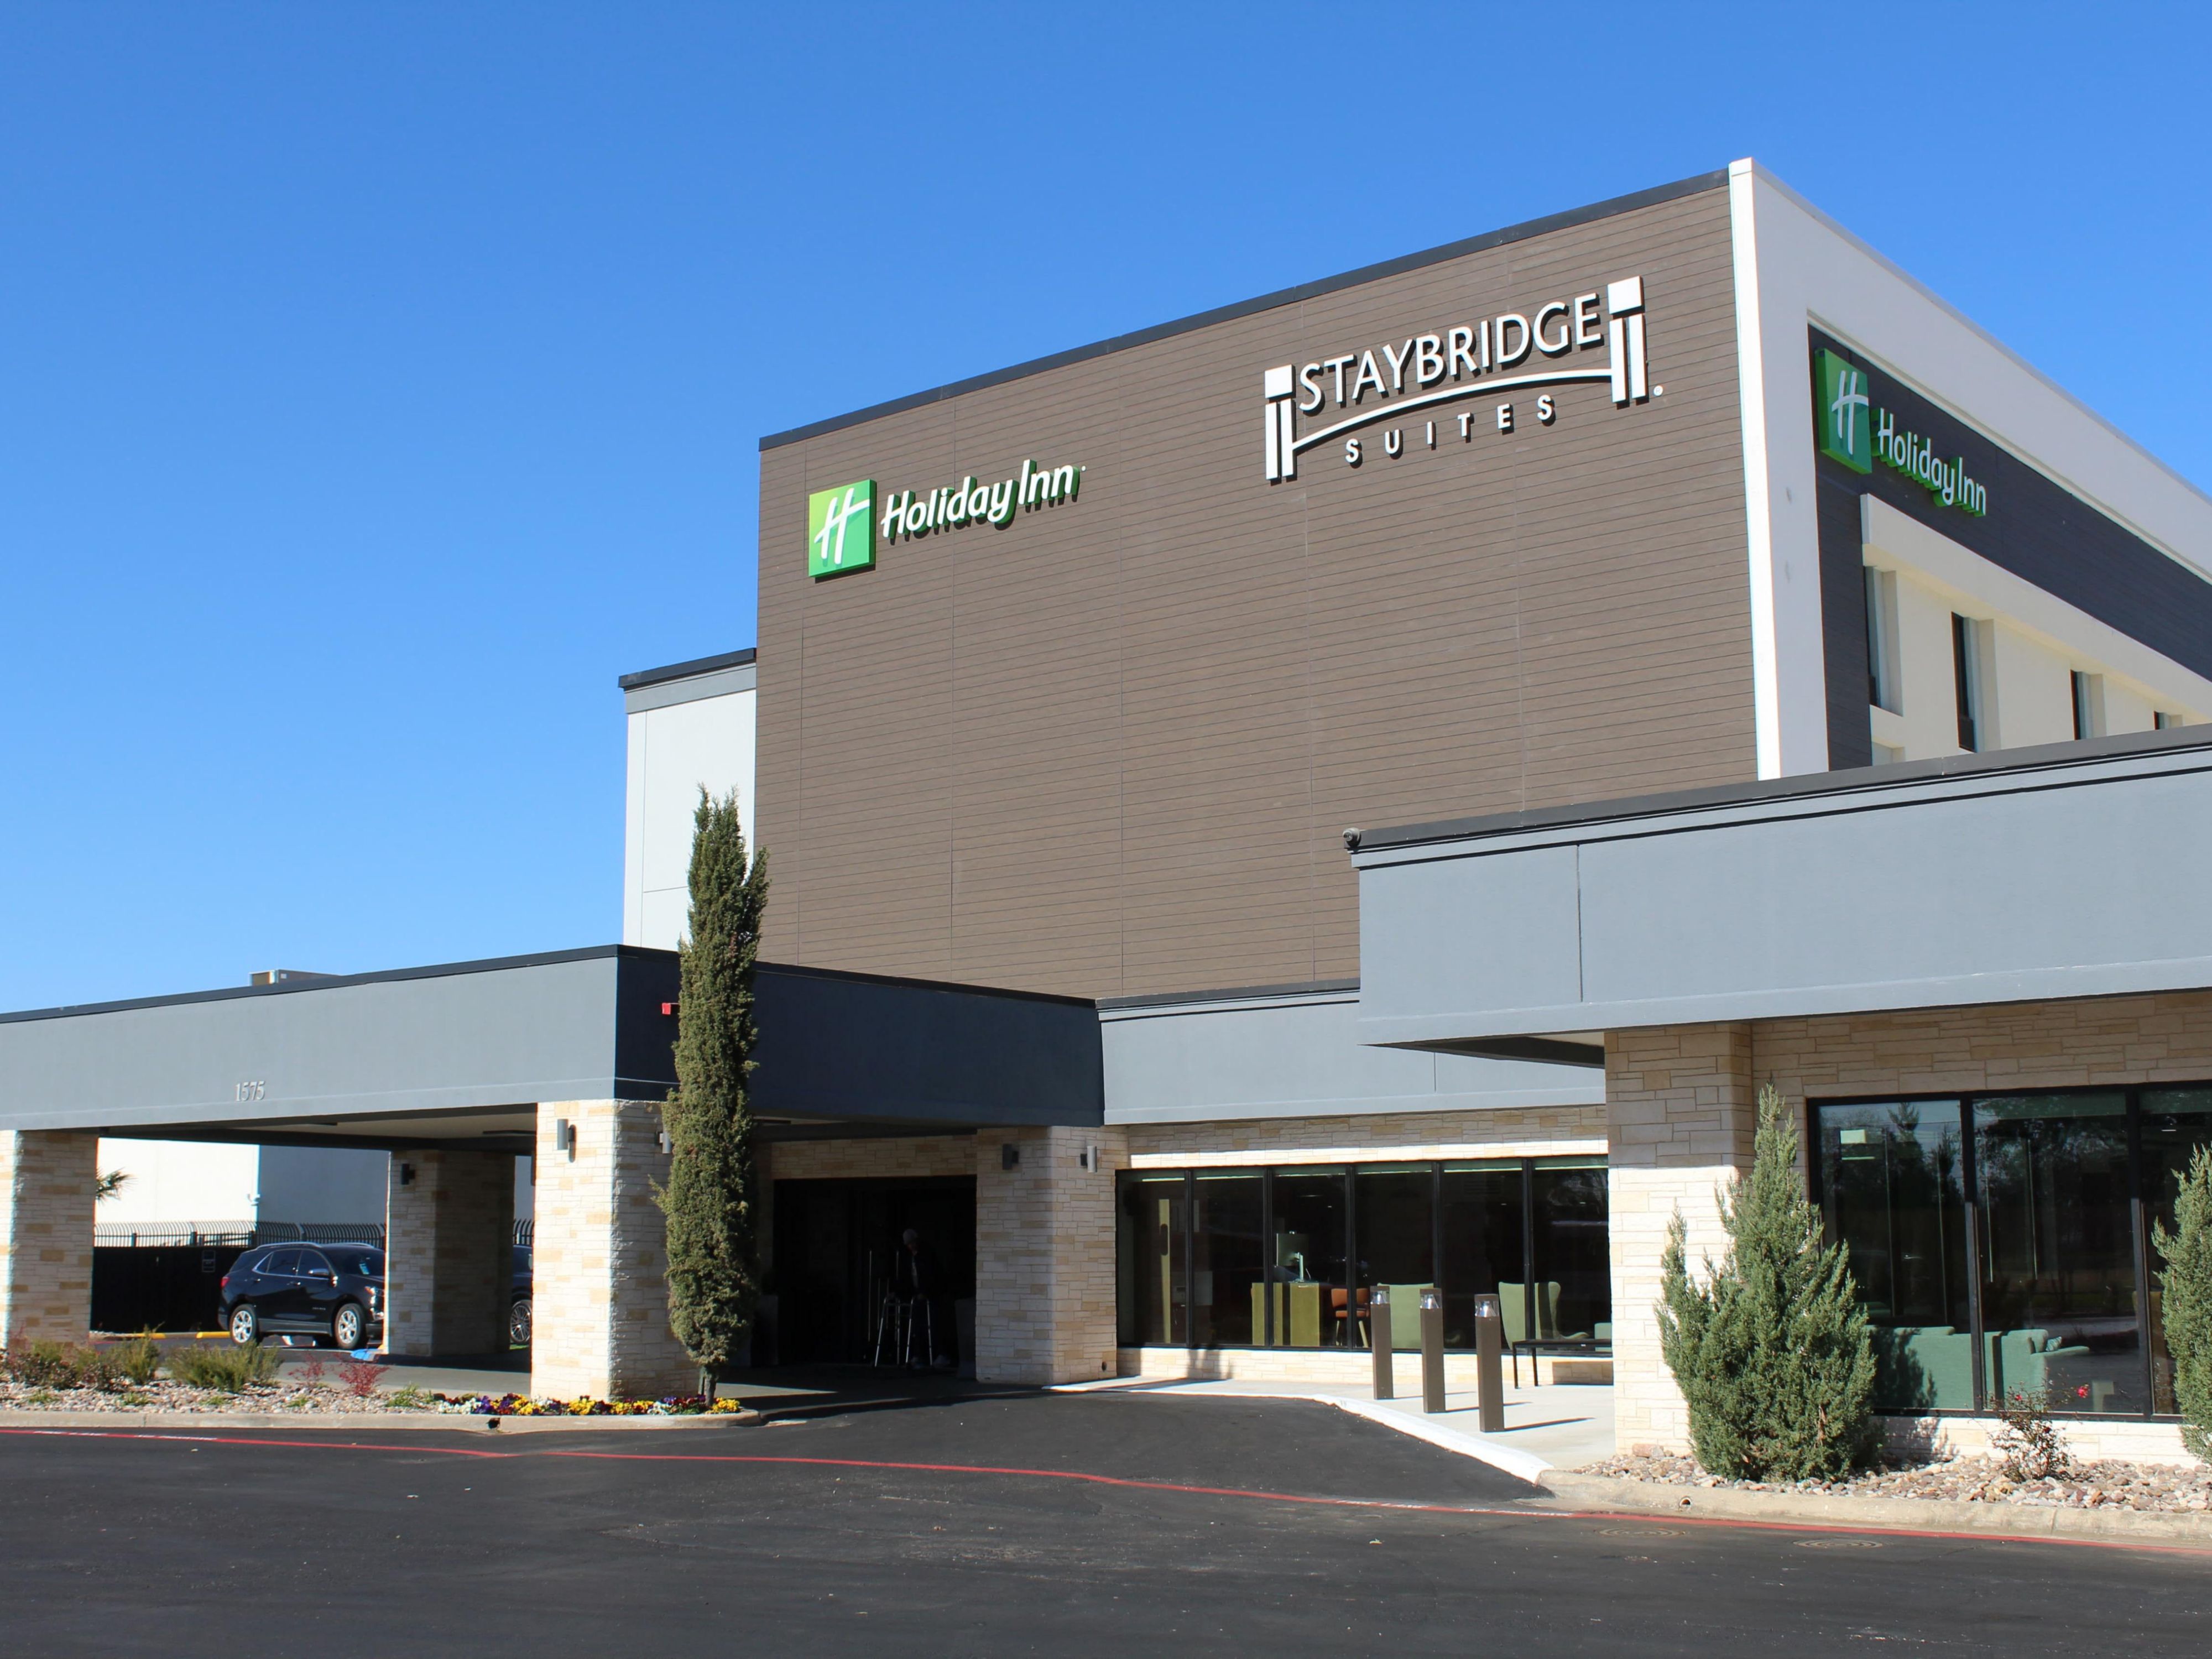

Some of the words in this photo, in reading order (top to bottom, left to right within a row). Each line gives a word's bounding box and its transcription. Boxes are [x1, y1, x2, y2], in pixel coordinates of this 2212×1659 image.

[1299, 293, 1602, 411] STAYBRIDGE
[1345, 394, 1554, 463] SUITES
[1831, 370, 1869, 455] H
[881, 476, 1016, 538] Holiday
[1018, 458, 1075, 505] Inn
[1877, 407, 1955, 505] Holiday
[1958, 457, 1986, 516] Inn
[814, 487, 870, 565] H
[235, 1081, 265, 1102] 1575
